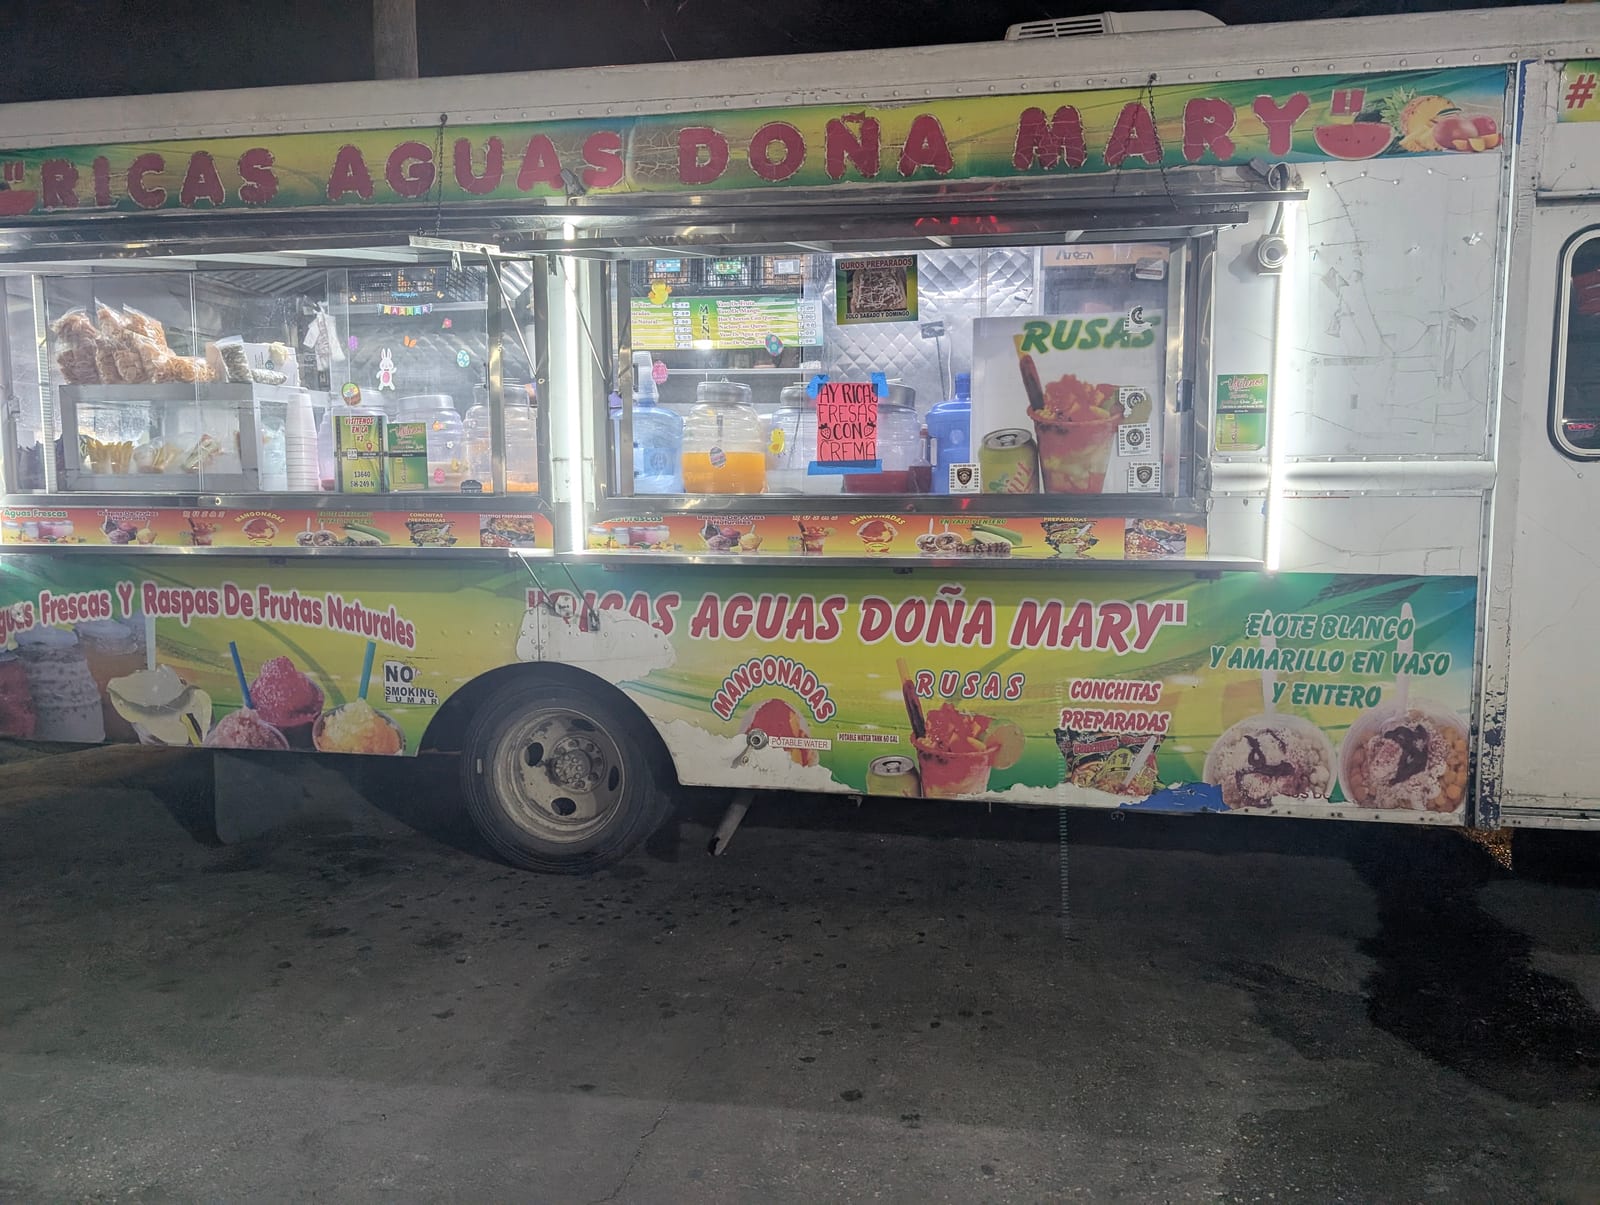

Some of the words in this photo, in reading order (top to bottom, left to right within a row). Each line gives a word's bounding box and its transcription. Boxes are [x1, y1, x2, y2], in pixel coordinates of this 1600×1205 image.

[1564, 73, 1597, 109] #
[326, 131, 625, 200] AGUAS
[677, 110, 955, 186] DOÑA
[840, 261, 865, 270] DUROS
[866, 258, 913, 269] PREPARADOS
[699, 303, 710, 341] MEN
[845, 312, 859, 320] SOLO
[860, 311, 880, 319] SABADO
[886, 310, 910, 319] DOMINGO
[1021, 317, 1163, 354] RUSAS
[818, 403, 877, 423] FRESAS
[833, 423, 863, 440] CON
[4, 509, 31, 518] Aguas
[33, 509, 67, 518] Frescas
[234, 511, 286, 523] MANGONADAS
[40, 590, 112, 628] Frescas
[117, 582, 134, 617] Y
[142, 582, 220, 626] Raspas
[223, 583, 253, 617] De
[257, 585, 323, 627] Frutas
[326, 593, 415, 649] Naturales
[690, 593, 847, 642] AGUAS
[858, 584, 994, 647] DOÑA
[1009, 600, 1185, 654] MARY"
[1246, 613, 1318, 639] ELOTE
[1320, 615, 1416, 642] BLANCO
[385, 665, 414, 683] NO
[1209, 645, 1226, 669] Y
[1226, 646, 1346, 673] AMARILLO
[1351, 650, 1385, 675] EN
[1391, 651, 1452, 677] VASO
[712, 656, 835, 721] MANGONADAS
[915, 671, 1025, 699] RUSAS
[1069, 679, 1163, 703] CONCHITAS
[1271, 681, 1286, 704] Y
[1291, 681, 1383, 709] ENTERO
[1059, 708, 1171, 733] PREPARADAS
[771, 738, 803, 747] POTABLE
[804, 739, 829, 748] WATER
[838, 733, 857, 742] POTABLE
[857, 734, 872, 742] WATER
[890, 735, 898, 743] GAL
